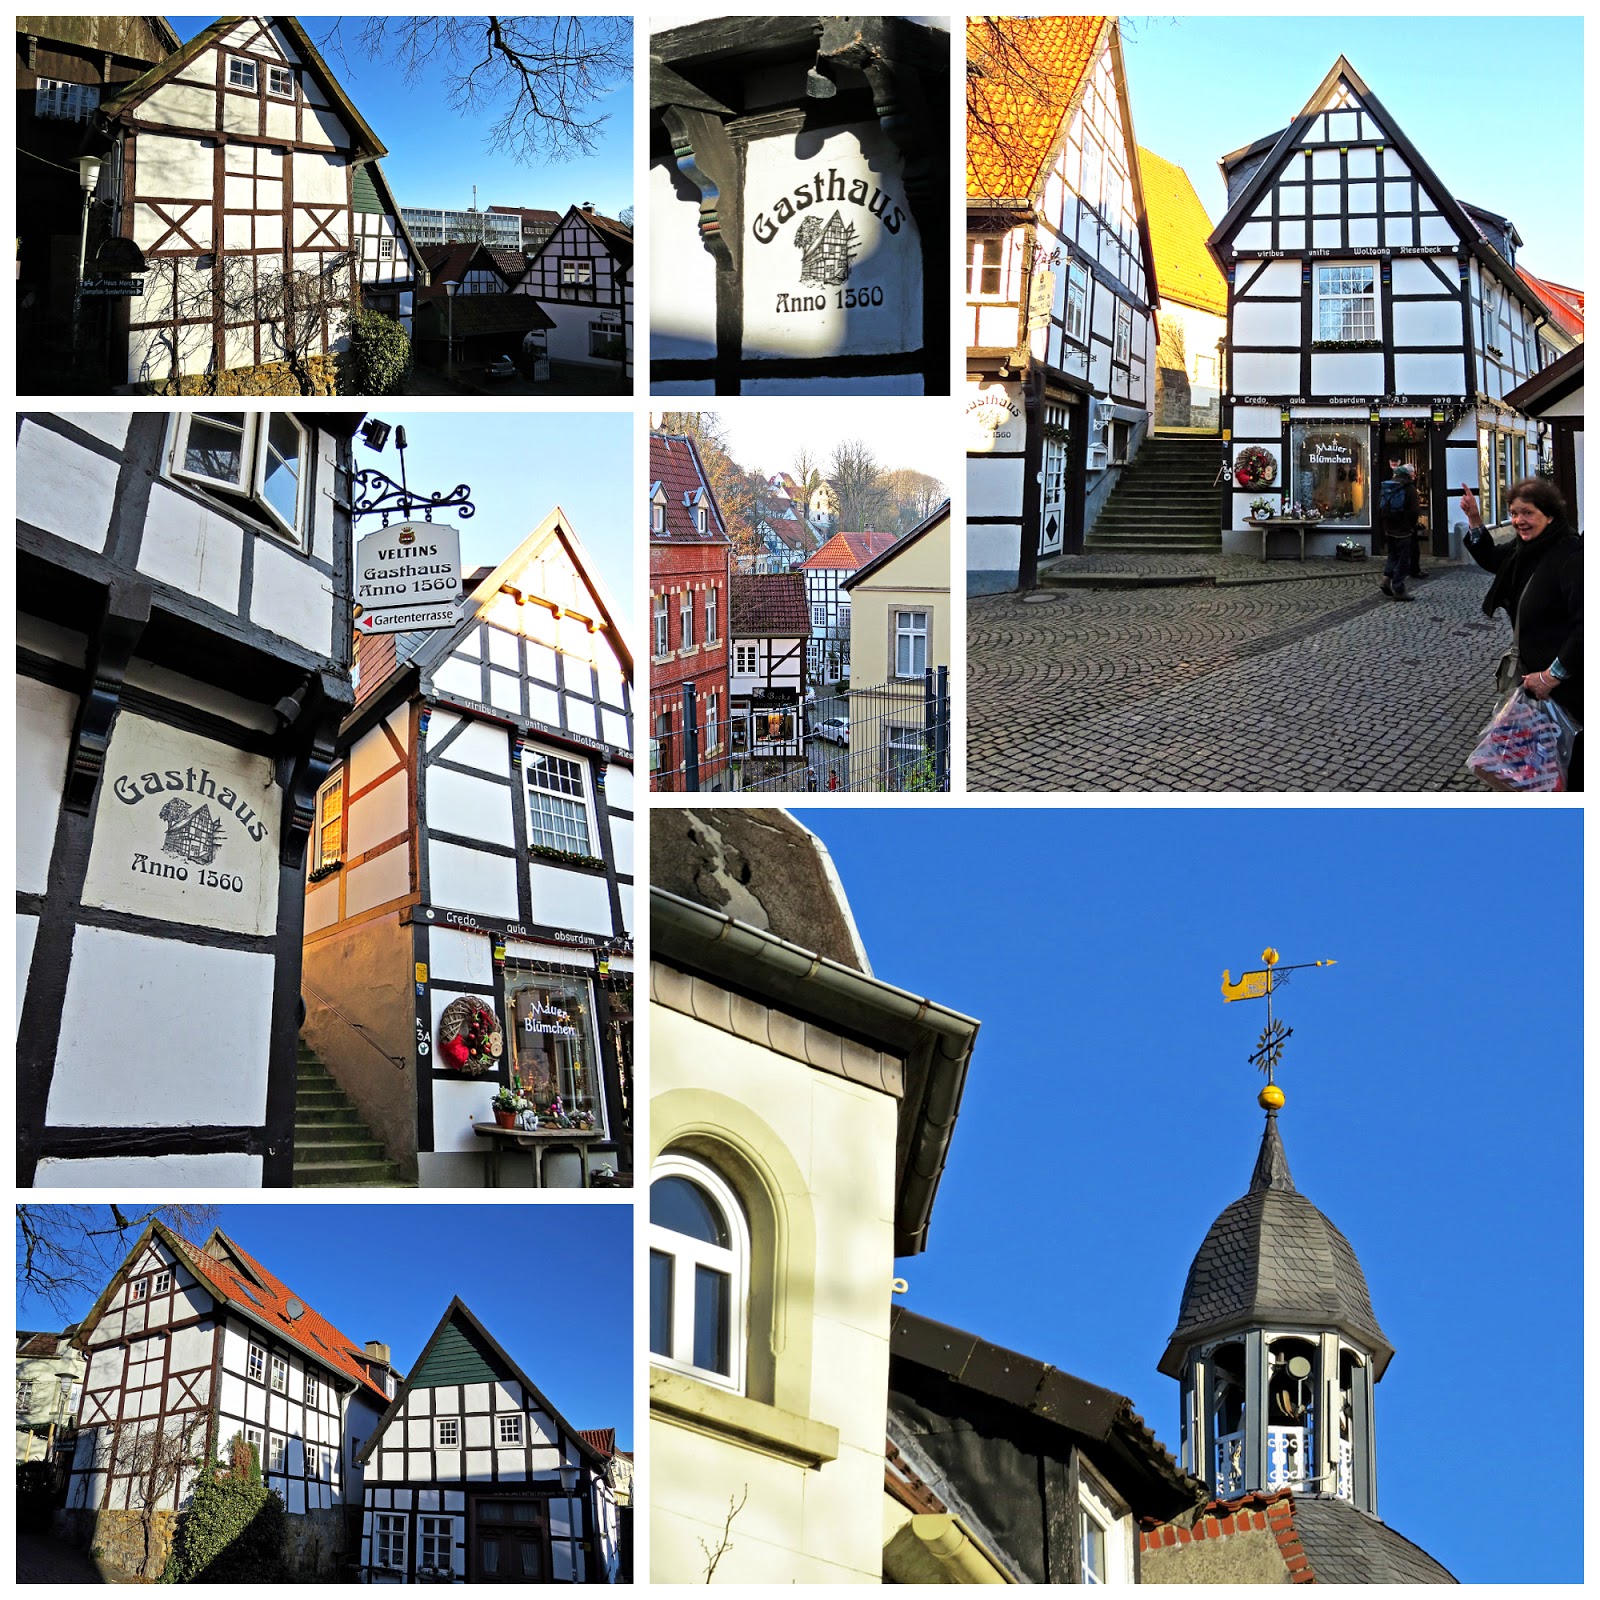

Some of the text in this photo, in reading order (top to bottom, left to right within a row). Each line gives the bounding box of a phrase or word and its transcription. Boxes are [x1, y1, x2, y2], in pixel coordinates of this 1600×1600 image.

[753, 168, 906, 244] Gasthaus
[776, 286, 883, 313] Anno 1560
[1315, 442, 1347, 454] Mauer
[1309, 454, 1352, 463] Blümchen
[378, 544, 437, 560] VELTINS
[364, 563, 452, 580] Gasthaus
[359, 577, 457, 597] Anno 1560
[374, 610, 453, 625] Gartenterrasse
[464, 700, 497, 717] viribus
[114, 767, 268, 842] Gasthaus
[131, 853, 243, 893] Anno 1560
[506, 924, 527, 935] quia
[554, 931, 596, 945] absurdum
[416, 1029, 431, 1042] 3A
[524, 1017, 576, 1036] Blümchen
